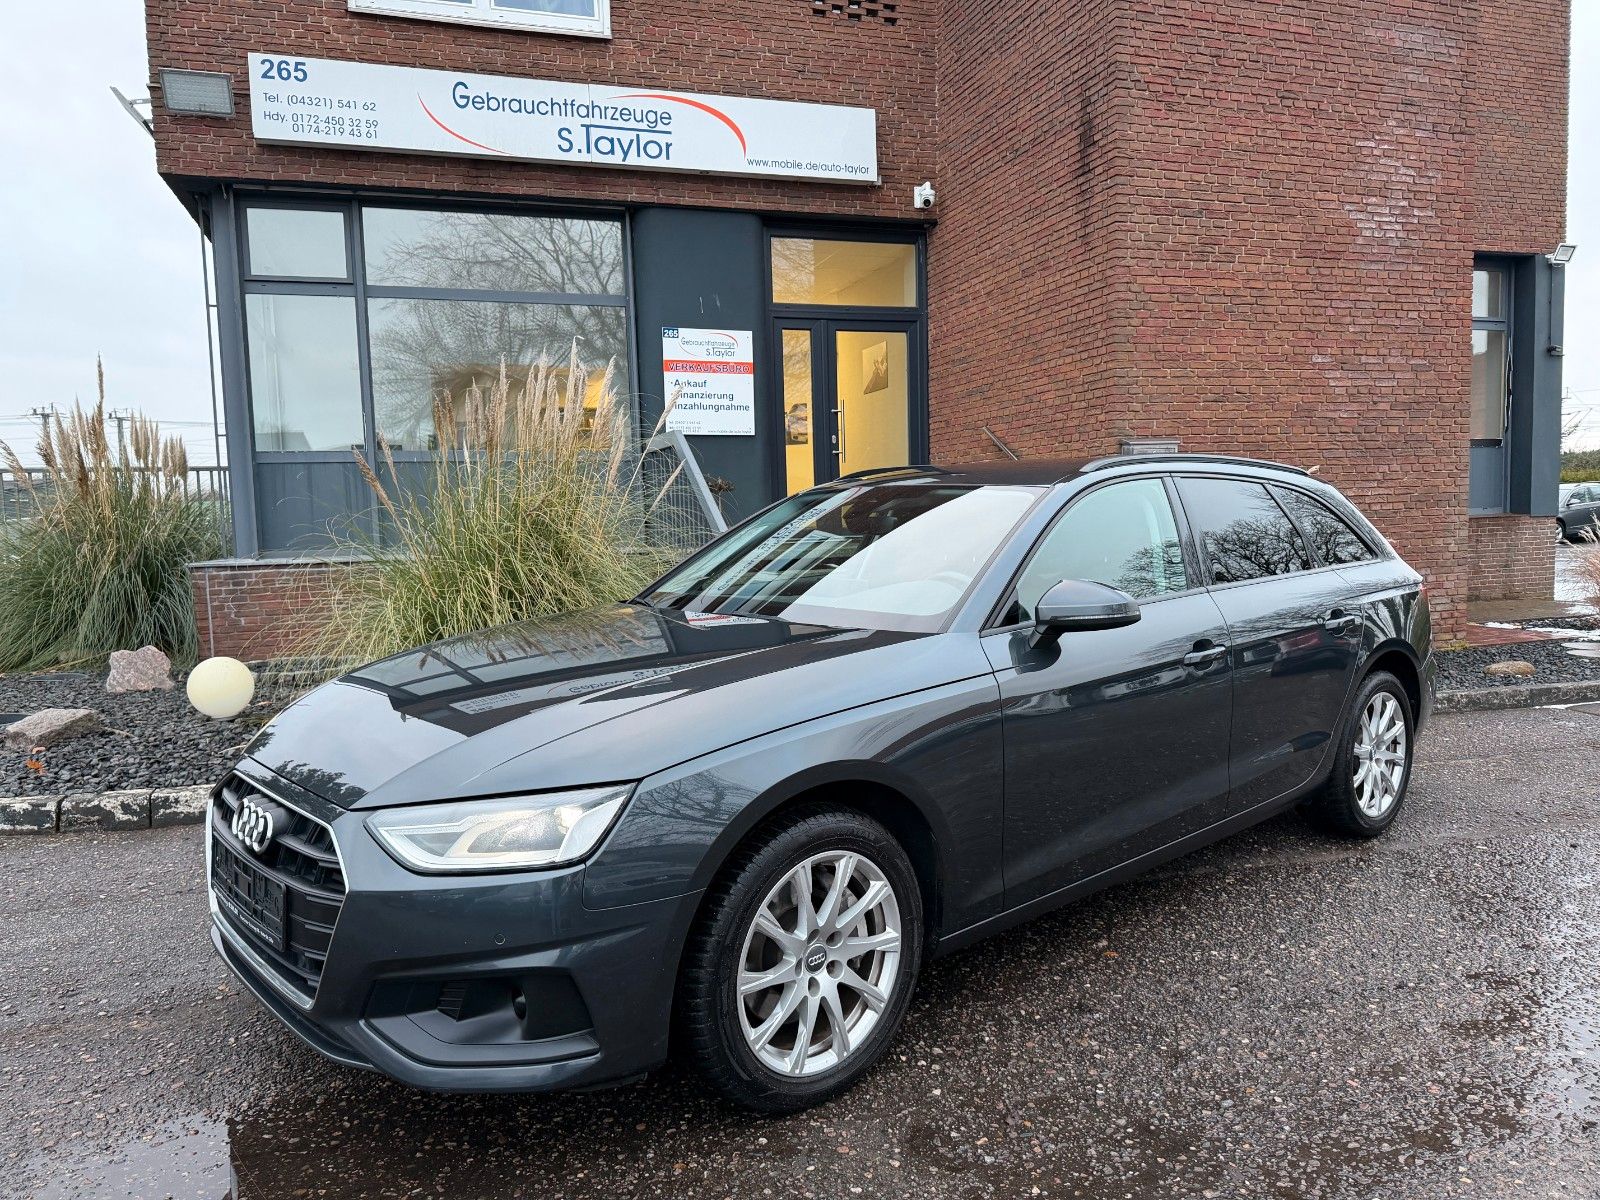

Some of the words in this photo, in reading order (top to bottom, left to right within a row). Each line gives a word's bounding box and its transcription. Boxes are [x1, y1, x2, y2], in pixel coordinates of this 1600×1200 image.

[260, 58, 308, 82] 265
[262, 92, 283, 103] Tel.
[287, 94, 333, 109] (04321)
[337, 99, 357, 110] 541
[362, 101, 377, 112] 62
[452, 81, 672, 129] Gebrauchtfahrzeuge
[263, 110, 288, 123] Hdy.
[291, 112, 345, 127] 0172-450
[348, 117, 362, 128] 32
[365, 119, 379, 129] 59
[292, 122, 345, 137] 0174-219
[348, 128, 363, 138] 43
[365, 129, 378, 139] 61
[557, 123, 673, 163] S.Taylor
[746, 158, 870, 176] www.mobile.de/auto-taylor
[663, 329, 679, 338] 265
[675, 390, 734, 401] inanzierung
